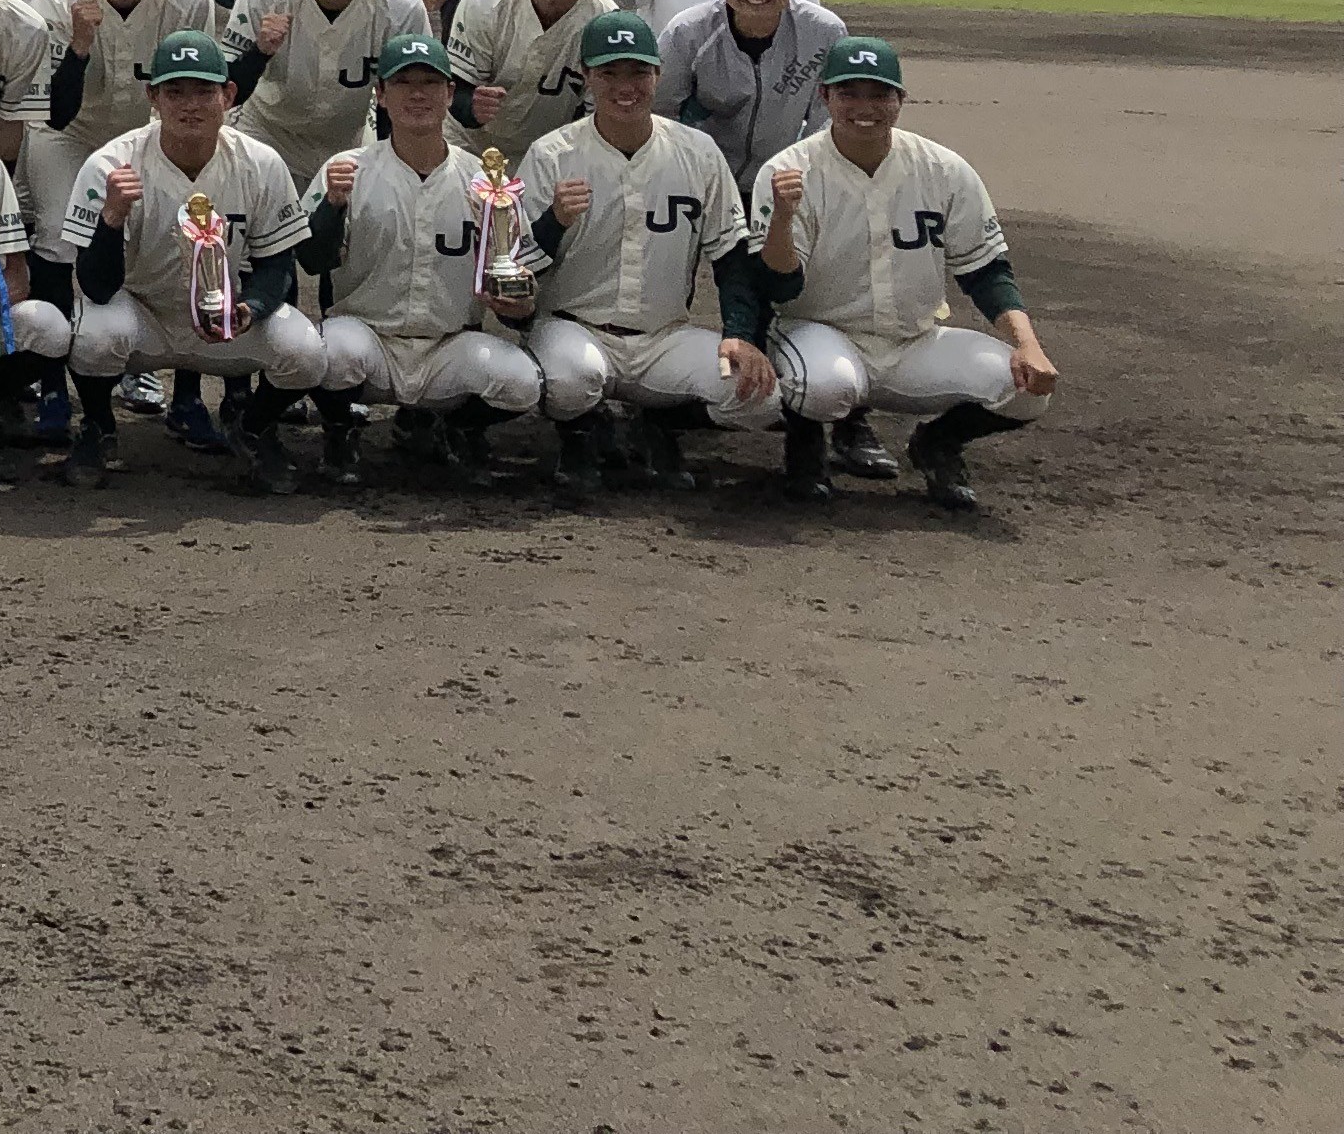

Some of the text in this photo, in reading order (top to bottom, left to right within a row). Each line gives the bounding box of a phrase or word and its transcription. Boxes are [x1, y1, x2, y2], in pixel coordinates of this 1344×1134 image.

[223, 28, 254, 52] OKYO
[401, 41, 429, 55] JR
[446, 37, 472, 59] OKYO
[607, 30, 635, 45] JR
[171, 47, 199, 61] JR
[848, 50, 878, 66] JR
[538, 66, 585, 98] JR
[773, 55, 802, 94] EAST
[789, 48, 828, 95] JAPAN
[72, 205, 99, 225] TOKY
[646, 195, 702, 233] JR
[436, 221, 480, 256] J
[892, 211, 945, 250] JR
